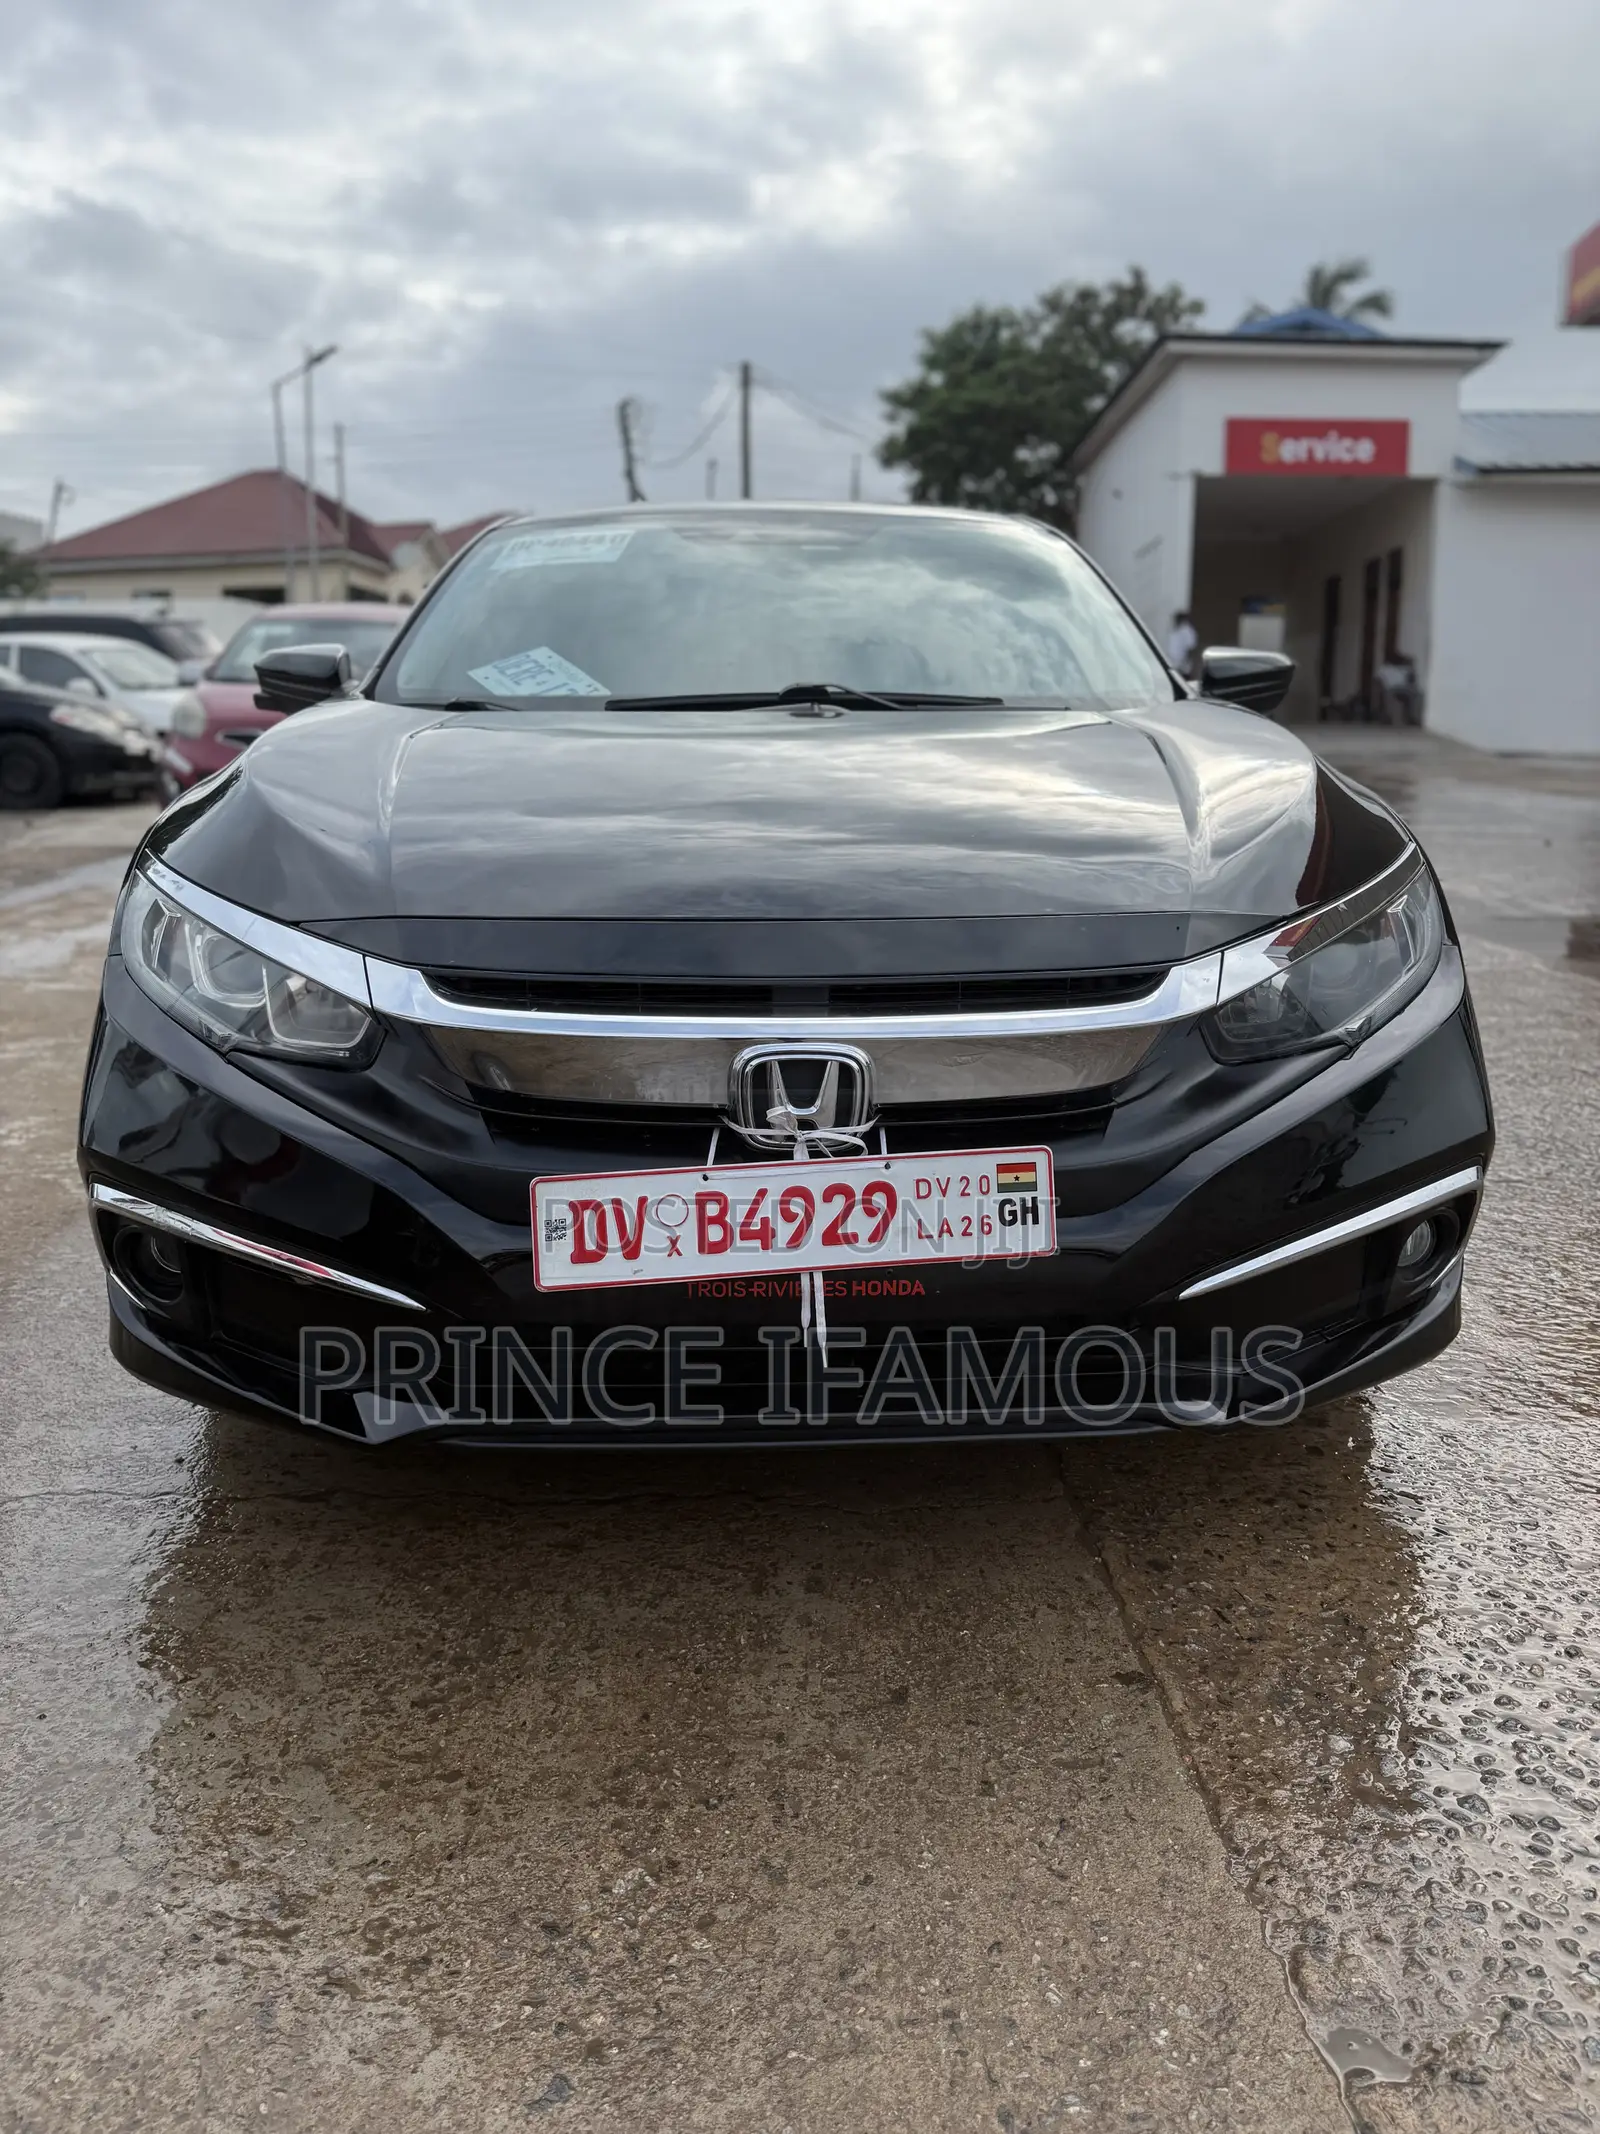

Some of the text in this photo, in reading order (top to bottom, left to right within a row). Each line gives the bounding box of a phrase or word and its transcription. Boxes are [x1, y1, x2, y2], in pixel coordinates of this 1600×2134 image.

[1261, 430, 1375, 464] Service
[569, 1196, 648, 1264] DV
[695, 1180, 897, 1255] B4929
[998, 1196, 1040, 1227] GH
[687, 1279, 926, 1298] TROIS-RIVIEES HONDA
